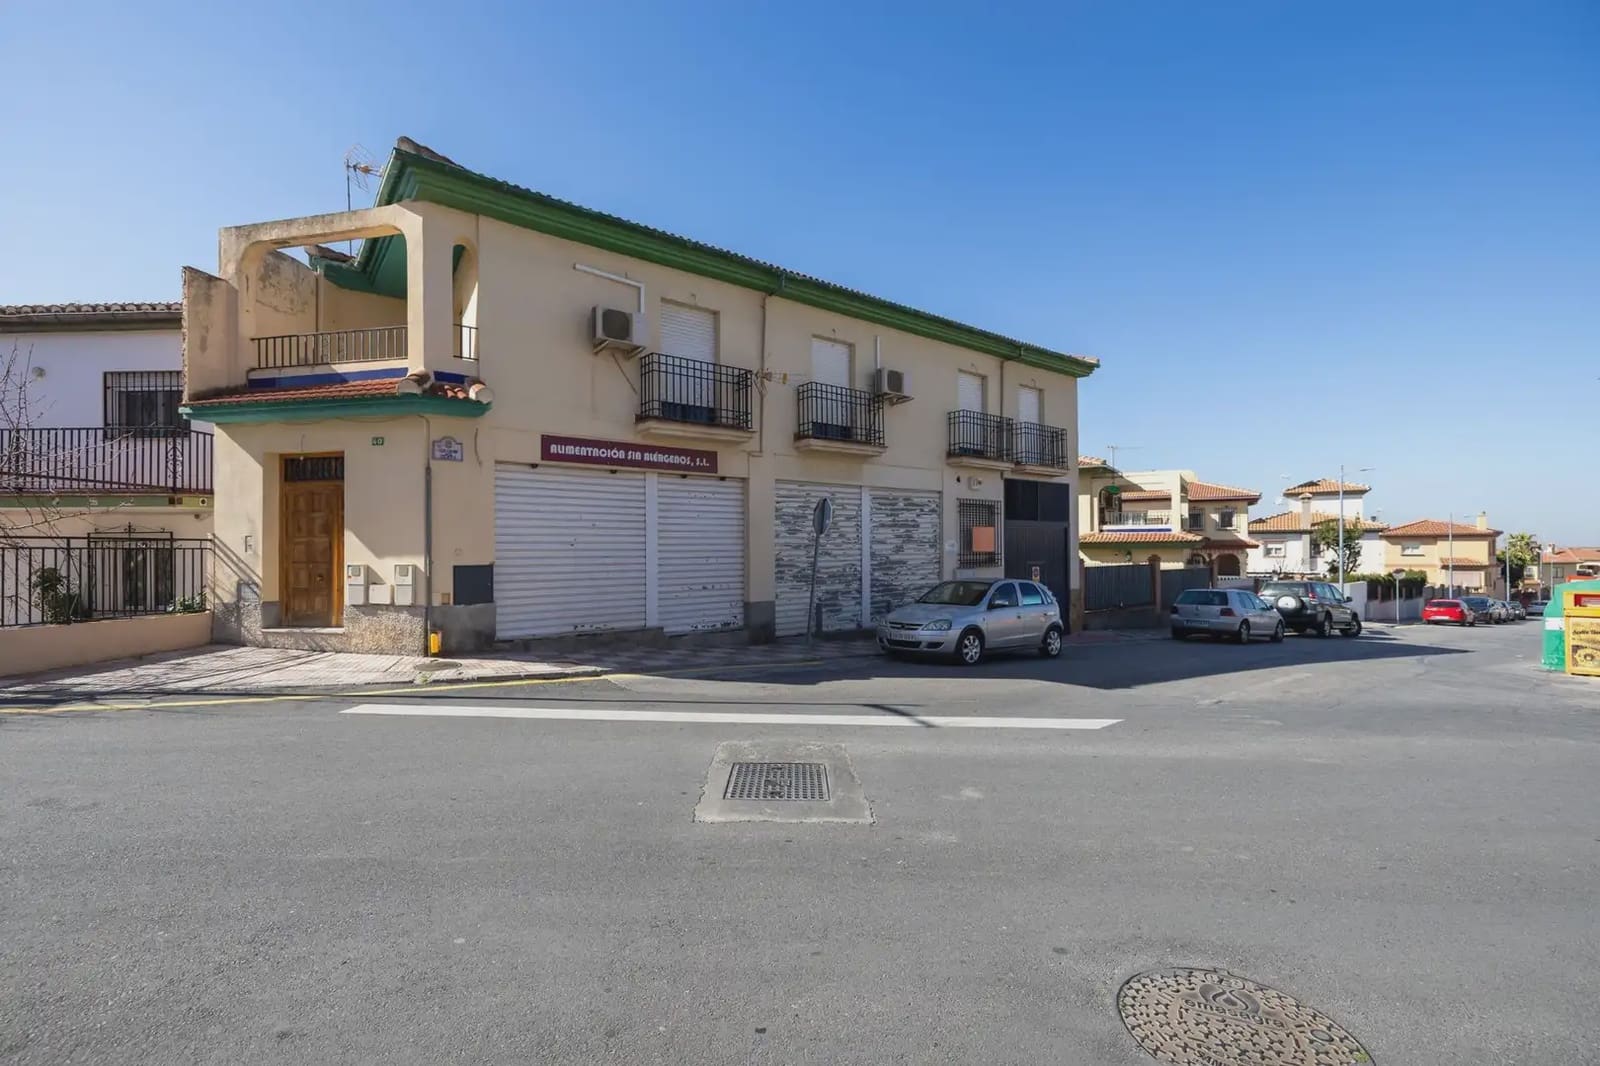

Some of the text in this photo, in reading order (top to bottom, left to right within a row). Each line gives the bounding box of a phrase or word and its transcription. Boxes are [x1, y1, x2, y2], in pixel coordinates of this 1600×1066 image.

[551, 444, 625, 459] ALIMENTACIÓN
[627, 449, 642, 461] SIN
[696, 457, 710, 467] S.L.
[1184, 999, 1285, 1028] emasagra
